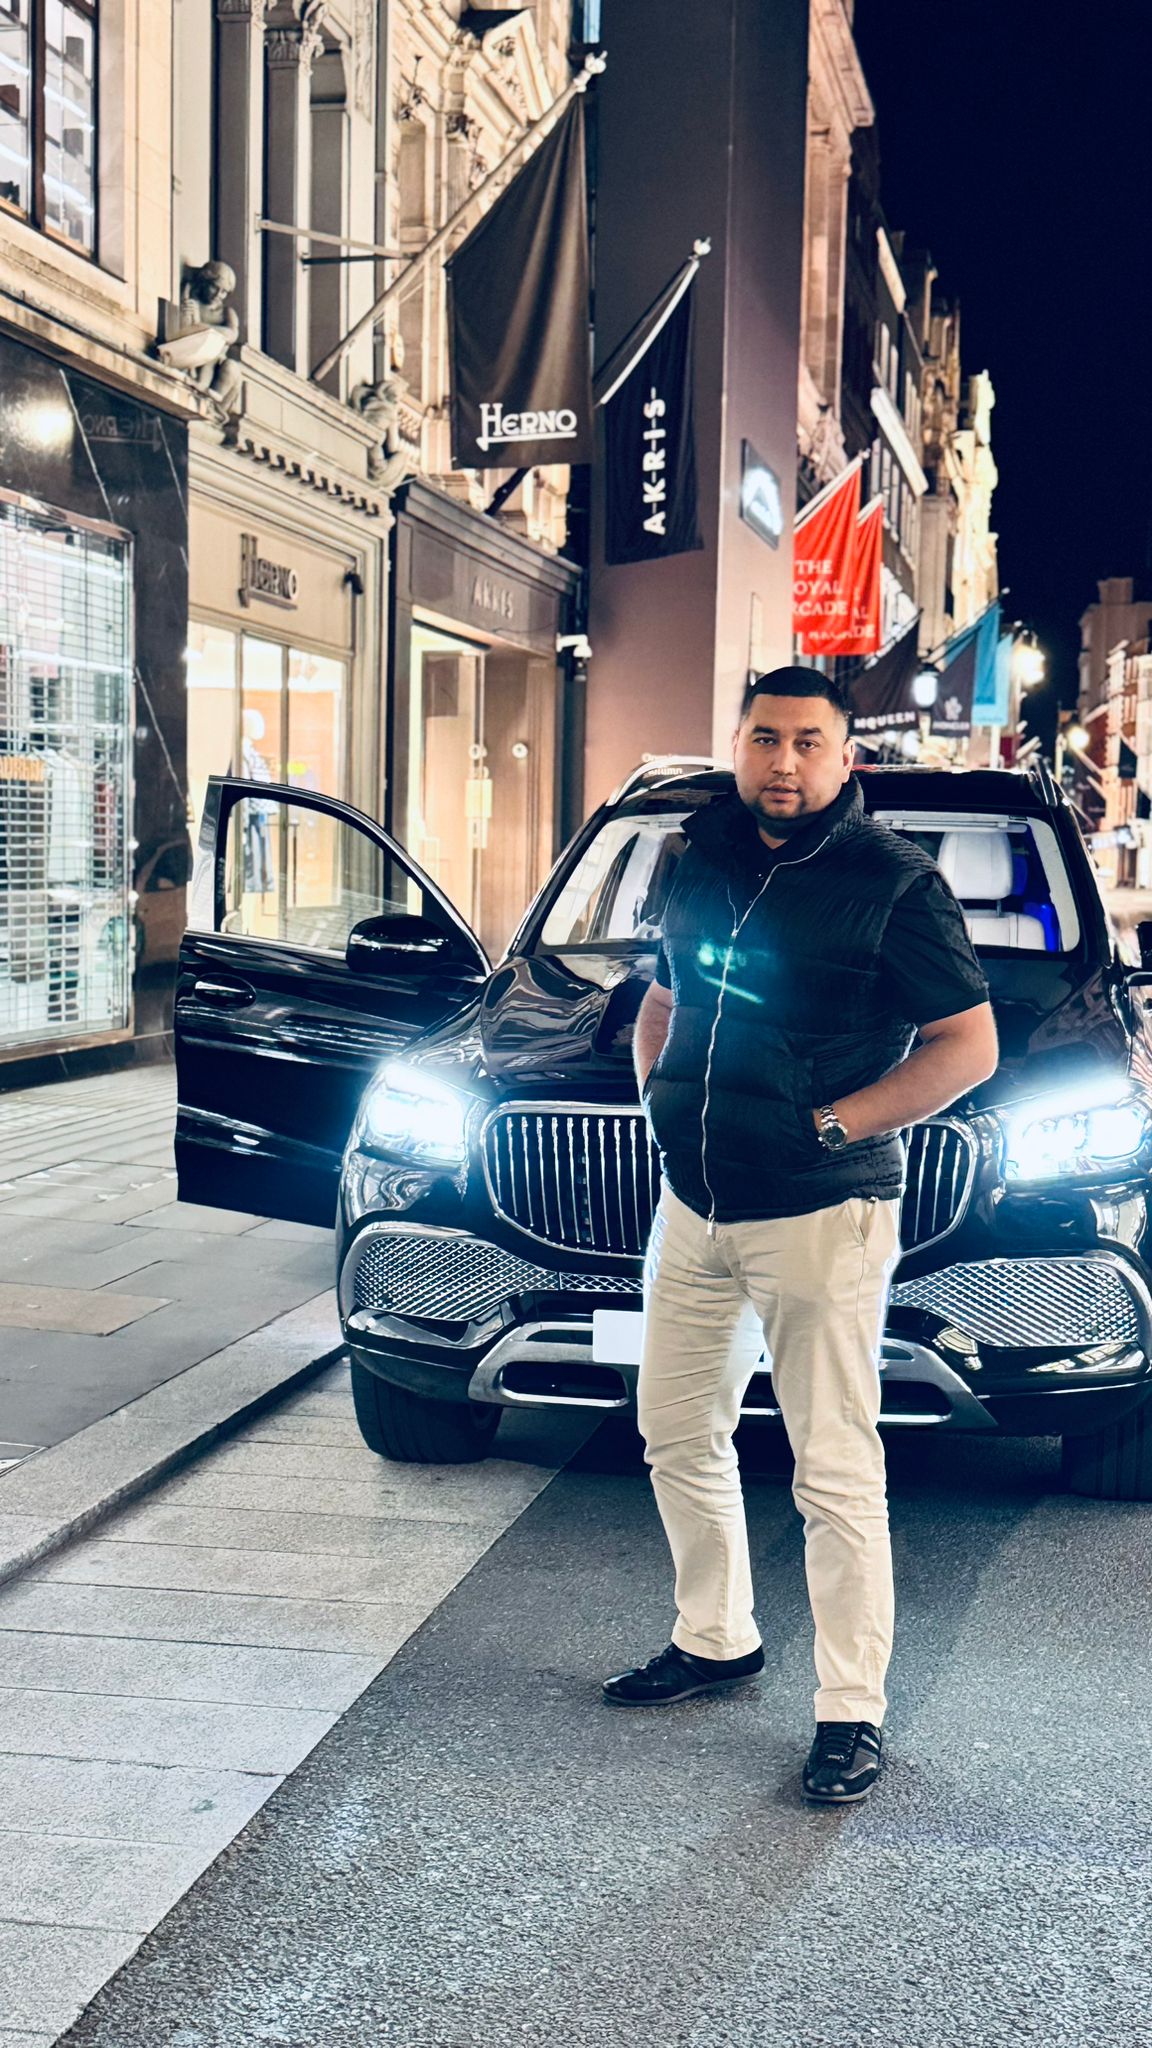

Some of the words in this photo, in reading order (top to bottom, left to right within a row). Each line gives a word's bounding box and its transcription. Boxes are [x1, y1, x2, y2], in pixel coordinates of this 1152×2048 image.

[476, 402, 578, 452] HERNO
[795, 559, 833, 575] THE
[793, 580, 843, 596] OYAL
